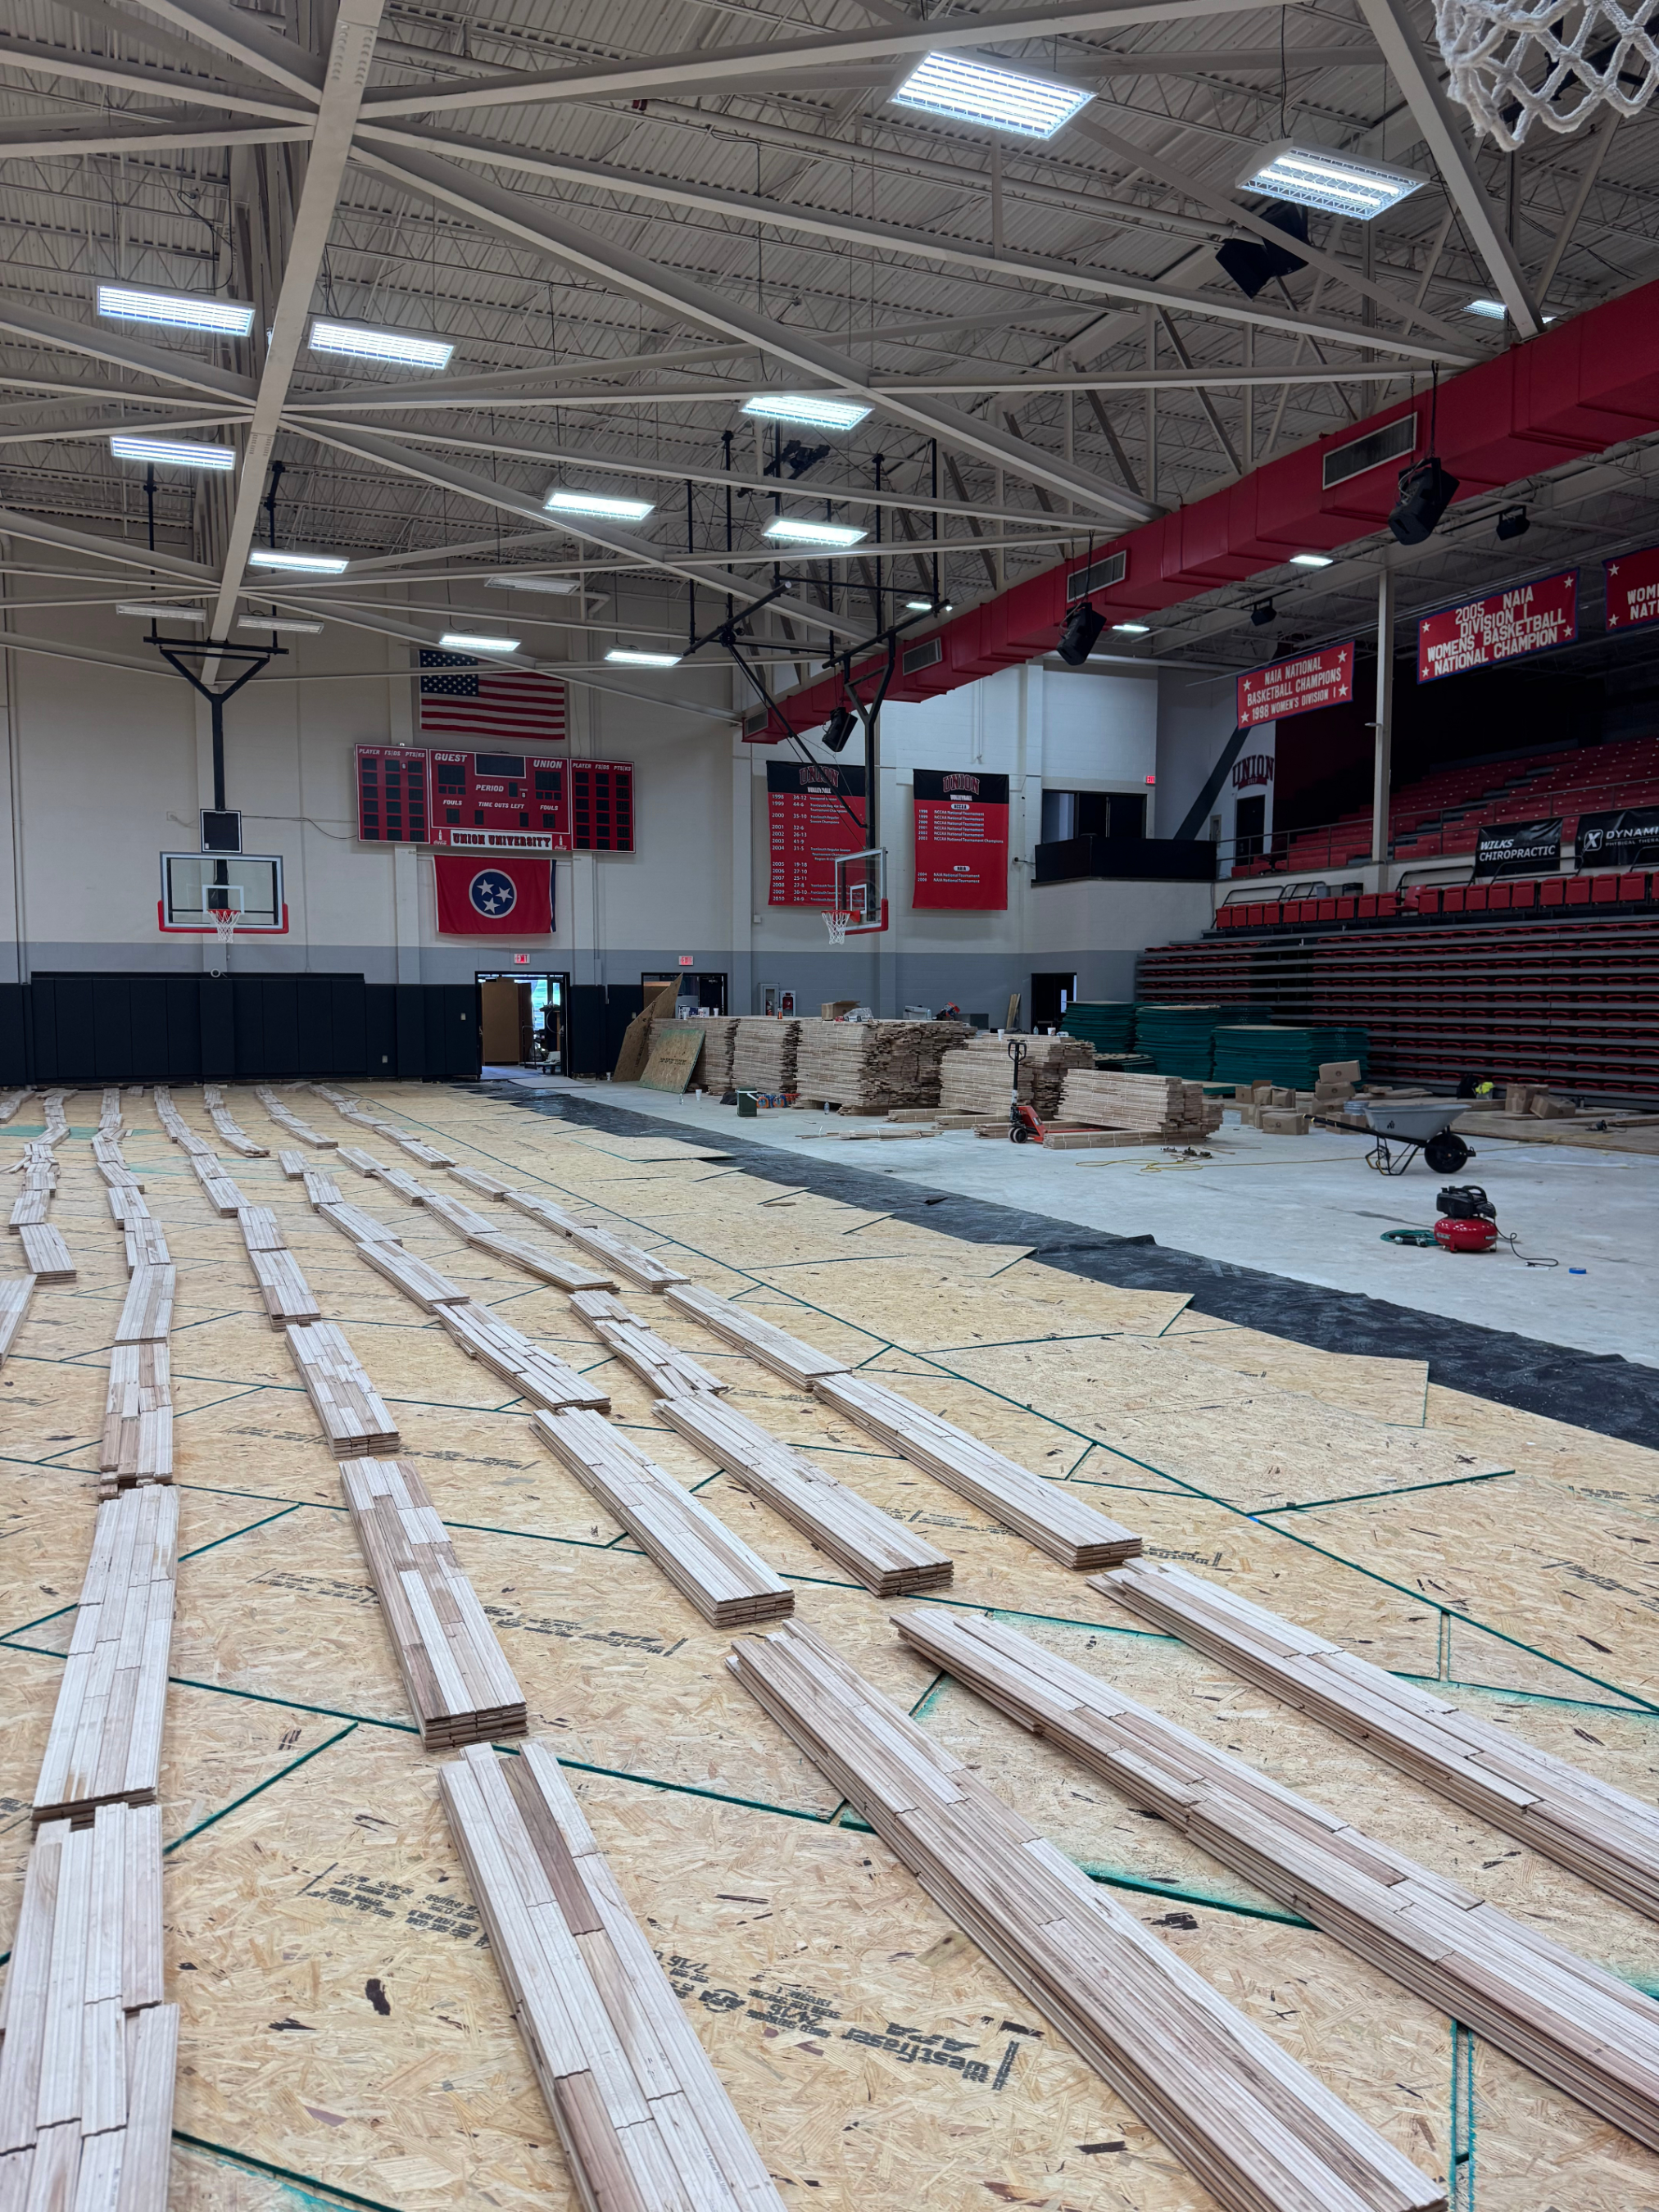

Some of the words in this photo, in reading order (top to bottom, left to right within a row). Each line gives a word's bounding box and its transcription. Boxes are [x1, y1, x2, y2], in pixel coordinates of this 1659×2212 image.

[1455, 601, 1484, 624] 2005
[1503, 586, 1534, 610] NAIA
[1427, 636, 1475, 662] WOMENS
[1483, 608, 1566, 646] BASKETBALL
[1460, 608, 1514, 638] DIVISION
[1435, 650, 1488, 676] NATIONAL
[1494, 627, 1557, 659] CHAMPION
[1265, 669, 1281, 685] NAIA
[1285, 656, 1322, 679] NATIONAL
[1247, 682, 1293, 706] BASKETBALL
[1296, 667, 1342, 693] CHAMPIONS
[1252, 705, 1268, 721] 1998
[1271, 697, 1299, 714] WOMEN'S
[1301, 688, 1329, 706] DIVISION
[434, 754, 467, 762] GUEST
[533, 760, 562, 768] UNION
[1232, 755, 1275, 788] UNION
[475, 784, 504, 793] PERIOD
[942, 773, 980, 795] UNION
[452, 832, 485, 845] UNION
[488, 834, 551, 847] UNIVERSITY
[1480, 839, 1514, 850] WILKS
[1480, 845, 1556, 862] CHIROPRACTIC
